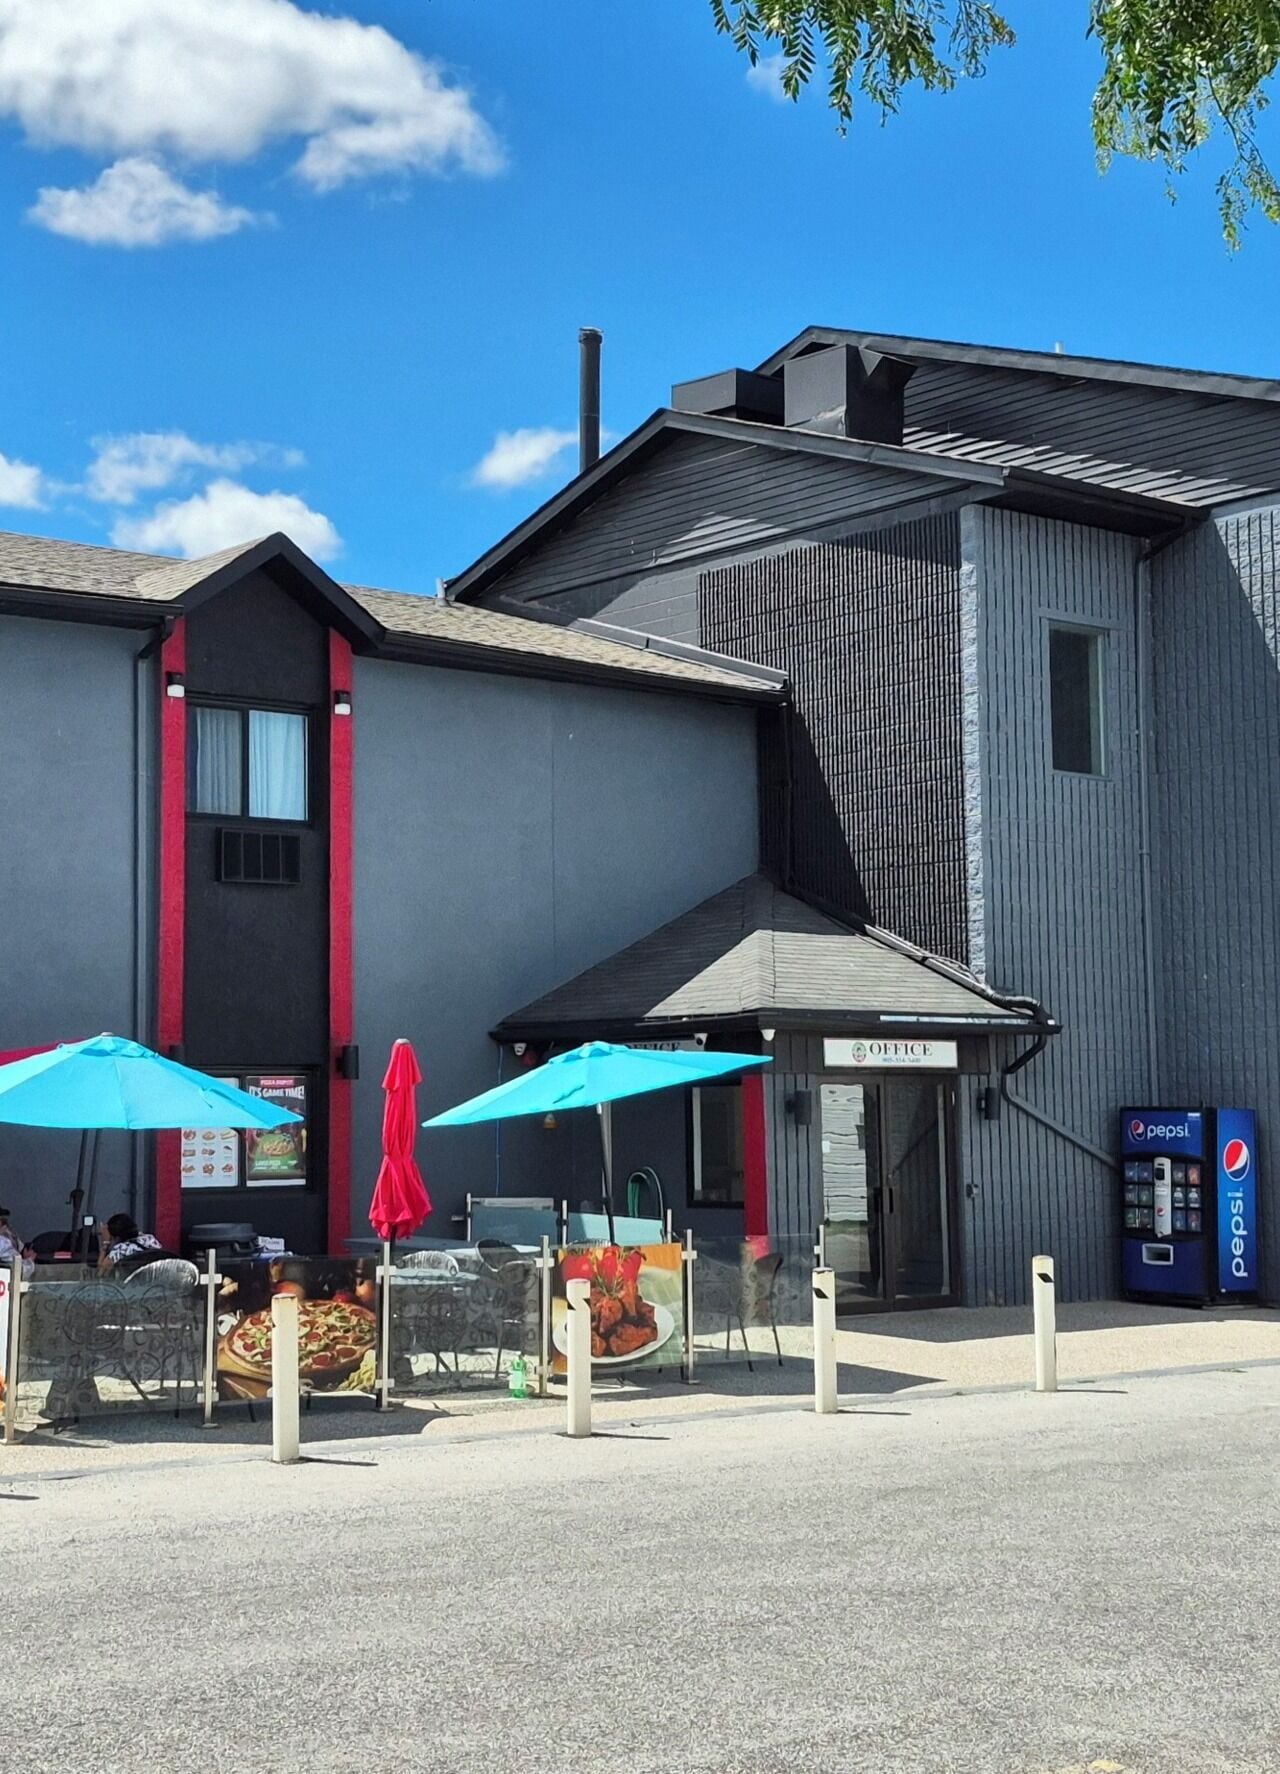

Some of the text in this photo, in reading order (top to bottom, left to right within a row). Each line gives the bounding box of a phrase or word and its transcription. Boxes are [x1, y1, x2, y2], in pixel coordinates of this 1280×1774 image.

[869, 1042, 933, 1056] OFFICE
[1147, 1123, 1189, 1141] pepsi
[1227, 1188, 1248, 1278] pepsi
